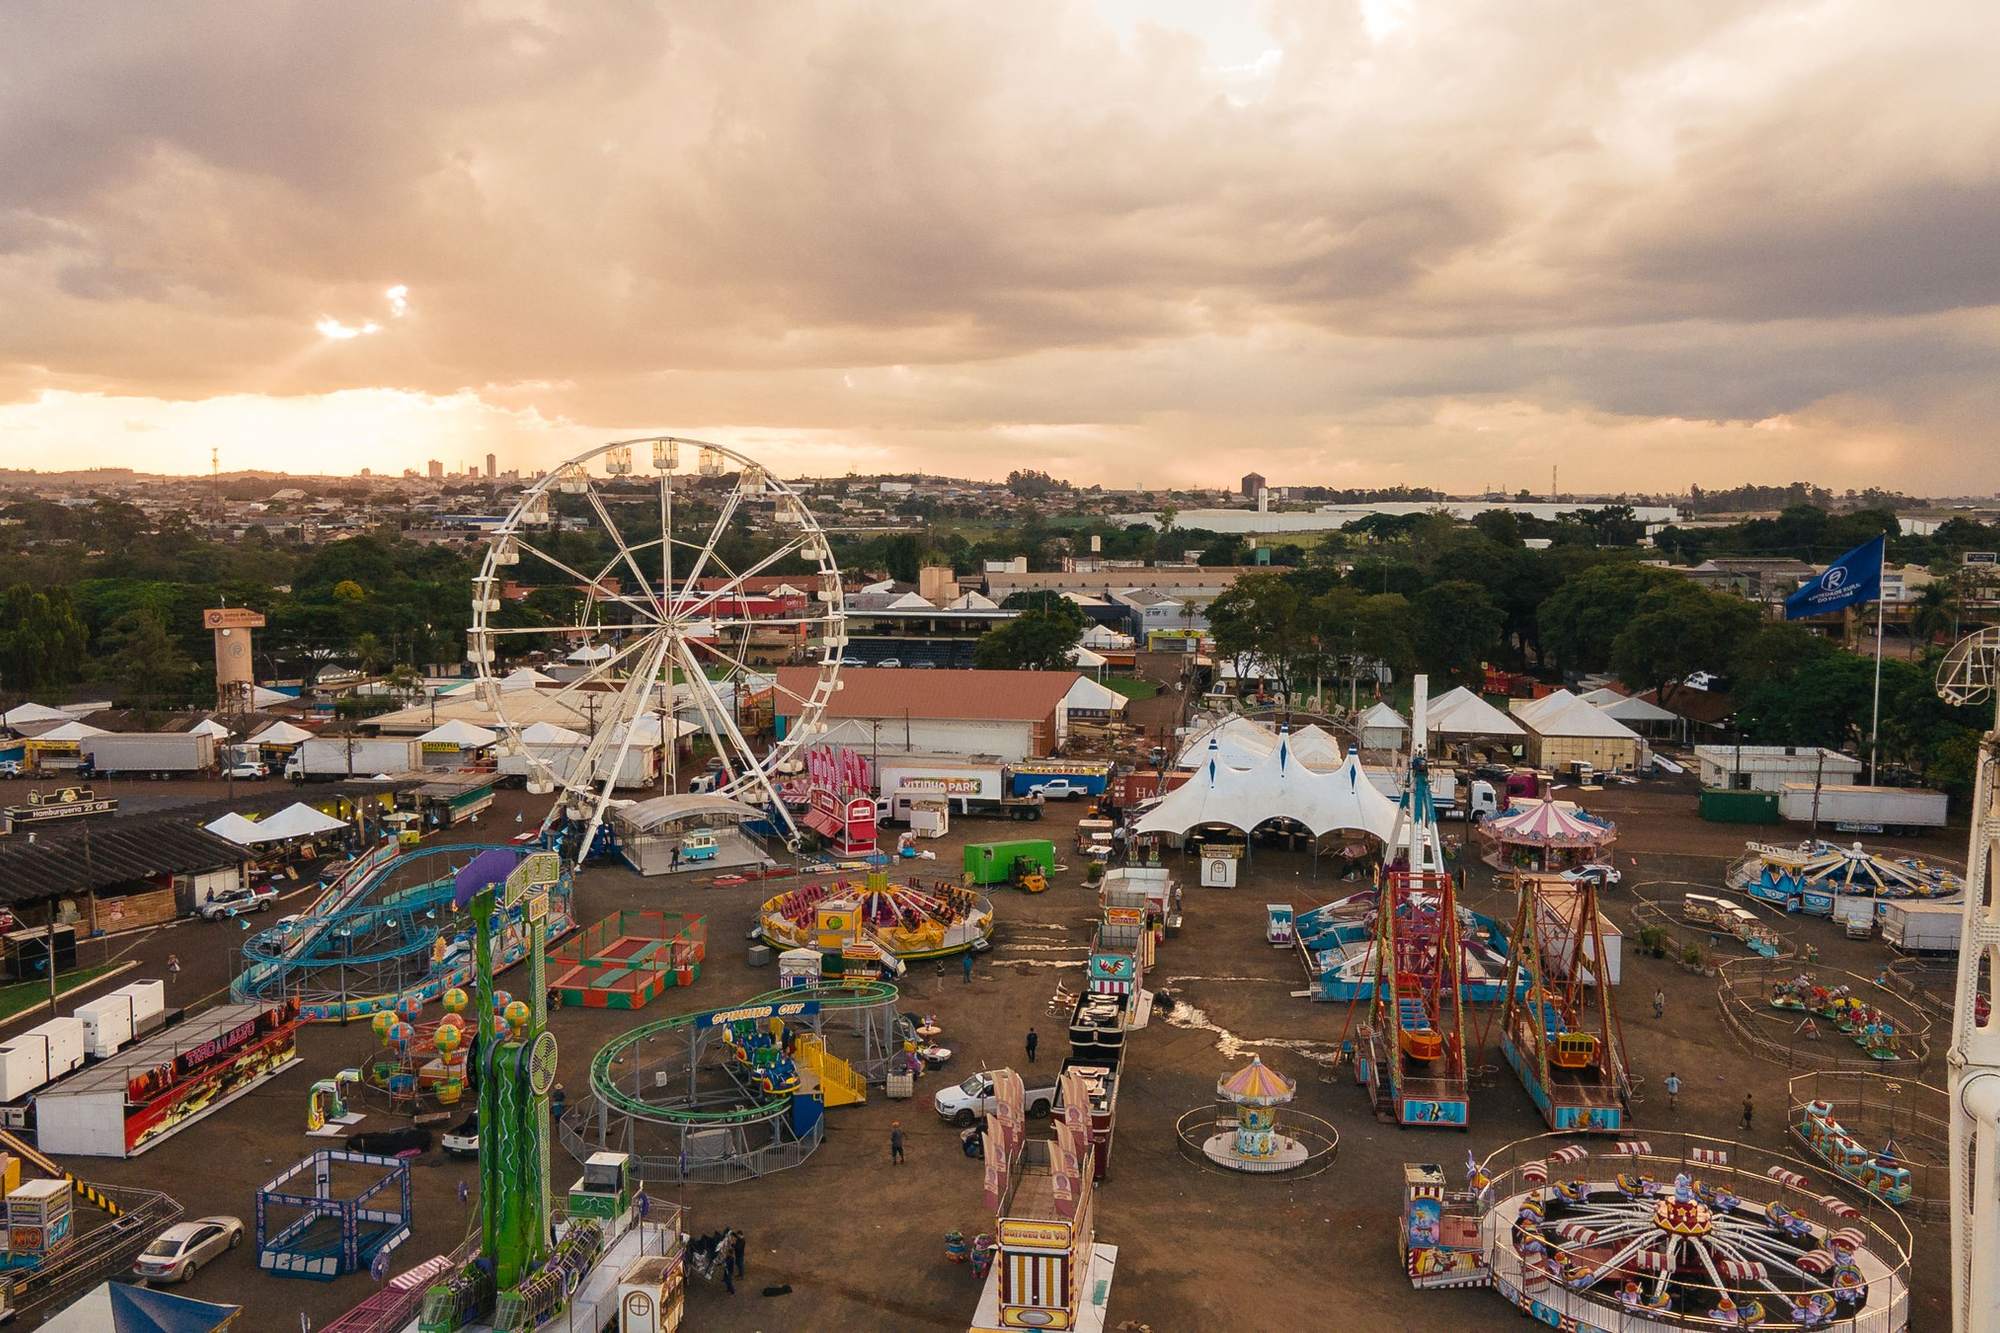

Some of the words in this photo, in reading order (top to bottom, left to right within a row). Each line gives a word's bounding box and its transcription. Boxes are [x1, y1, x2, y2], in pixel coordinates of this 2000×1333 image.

[948, 780, 978, 792] PARK
[712, 1005, 773, 1025] SPINNING
[778, 1003, 805, 1016] OUT
